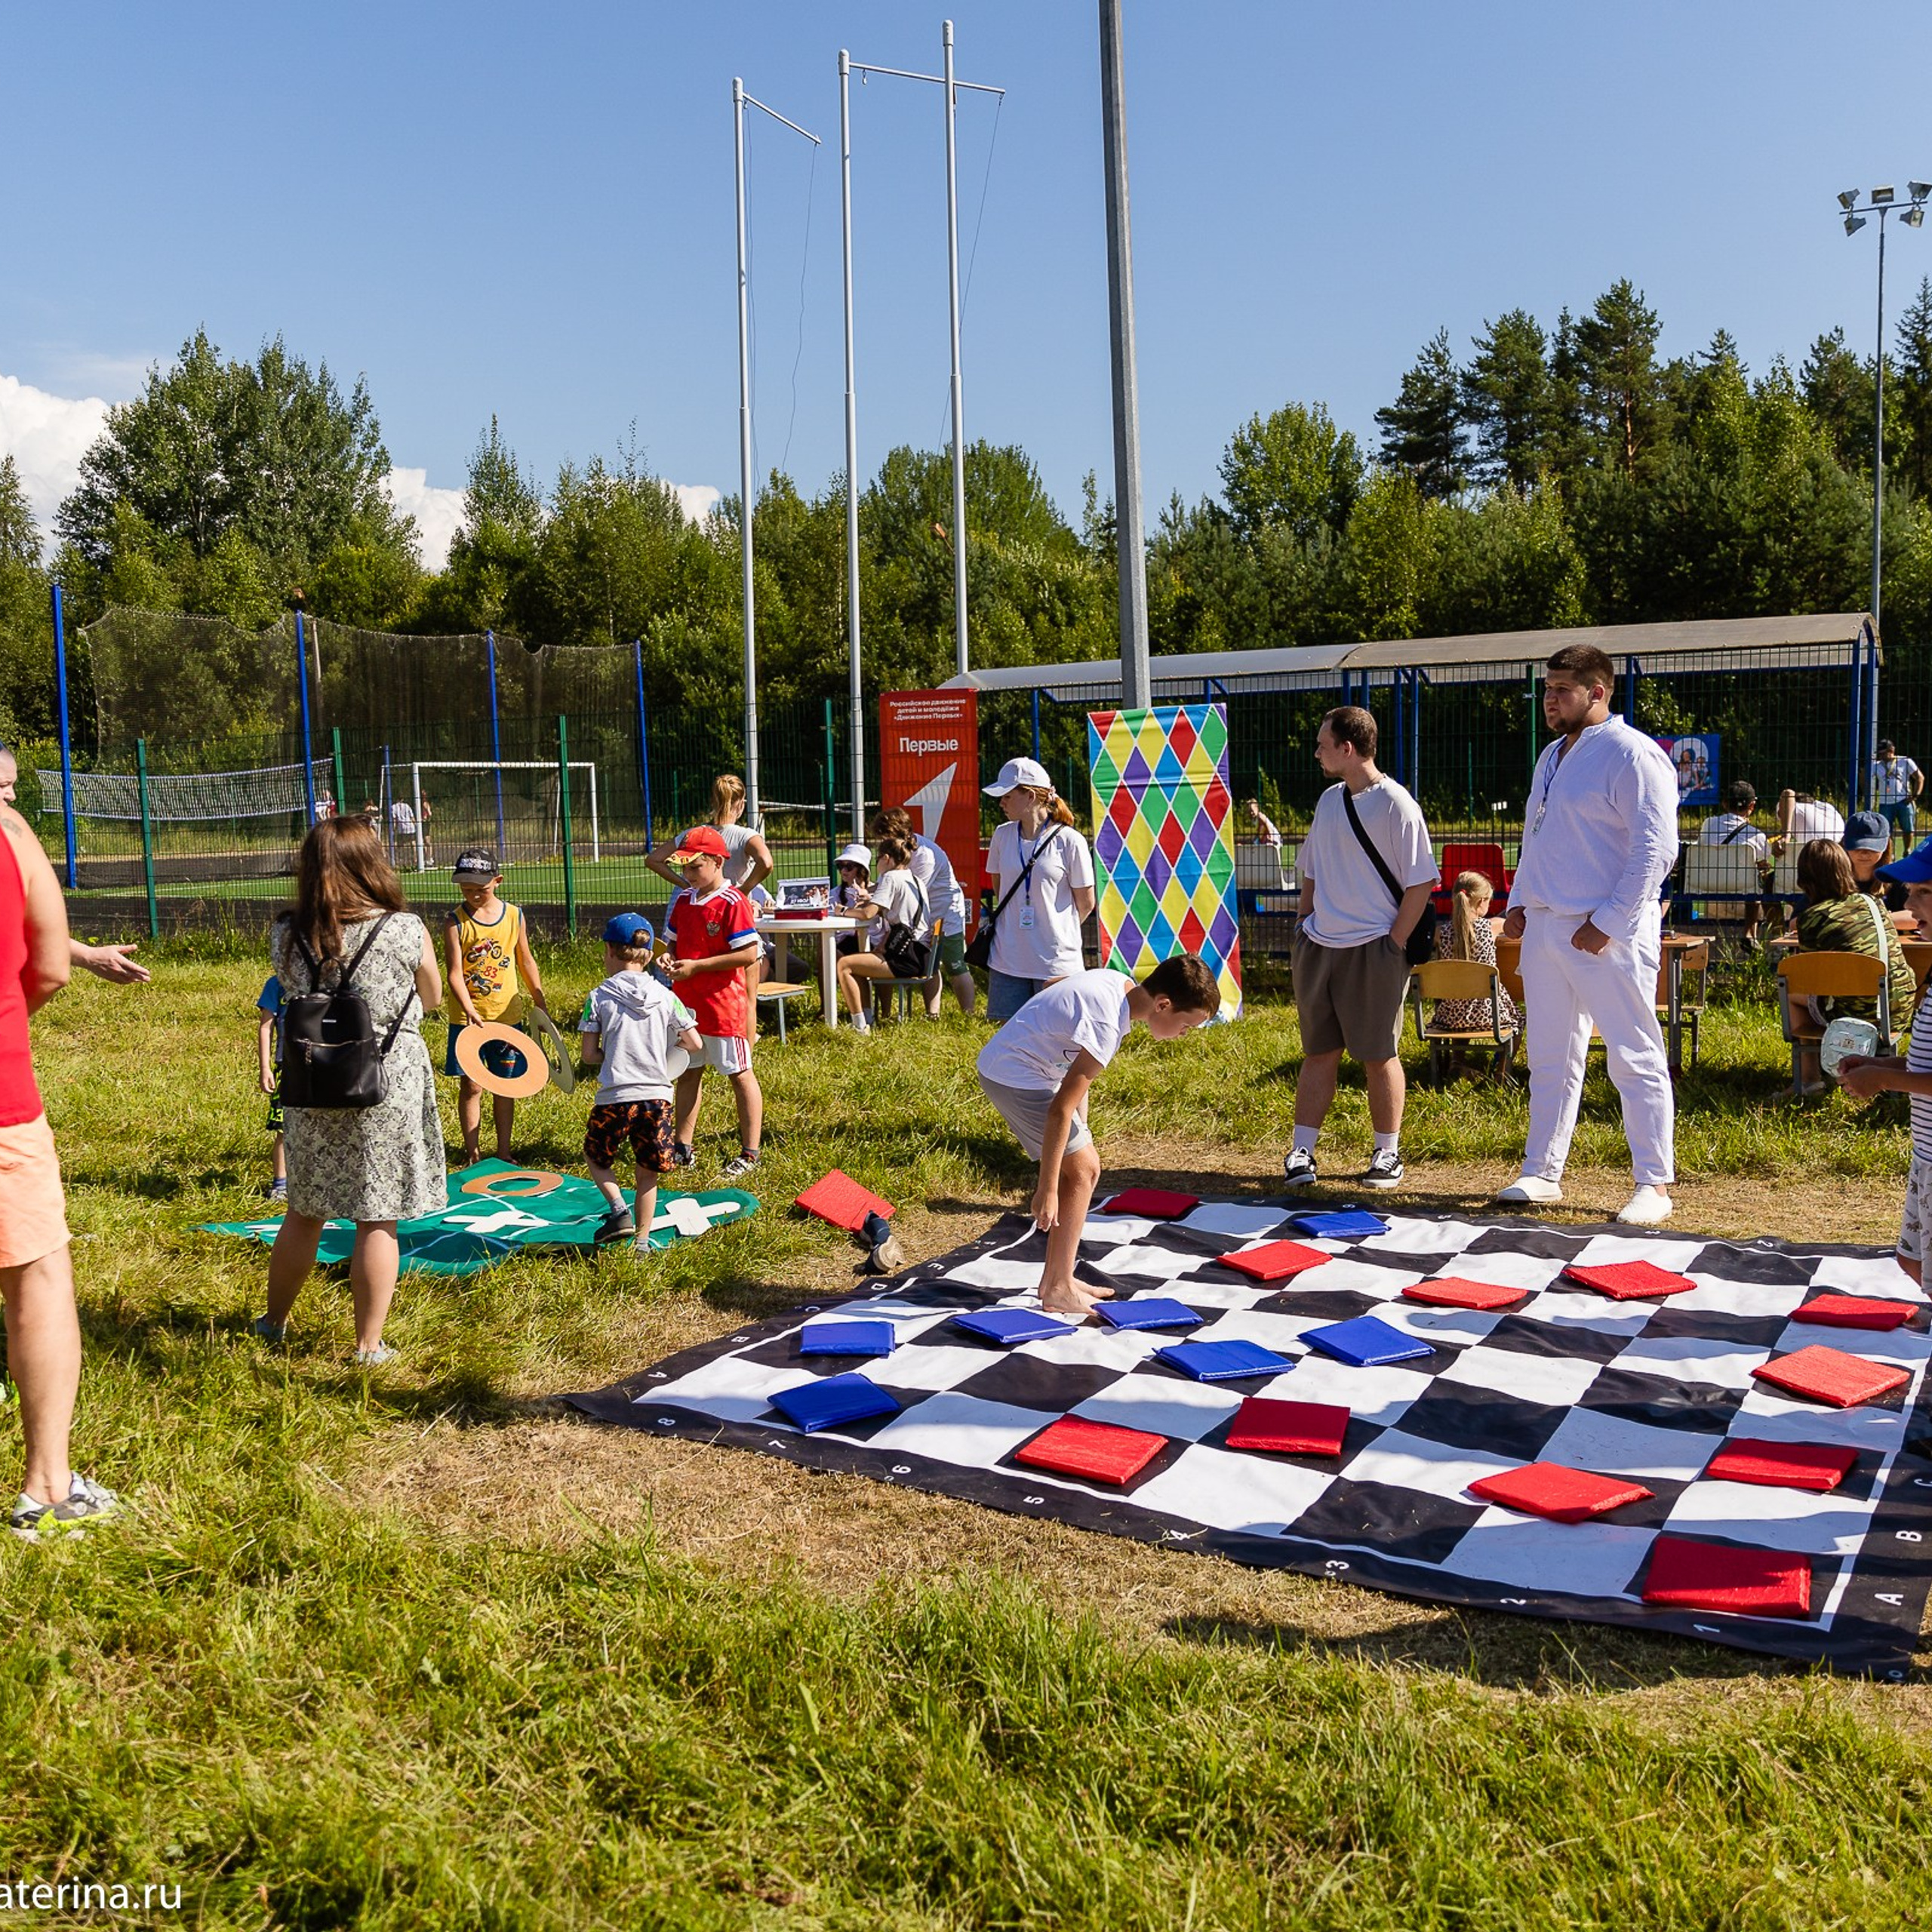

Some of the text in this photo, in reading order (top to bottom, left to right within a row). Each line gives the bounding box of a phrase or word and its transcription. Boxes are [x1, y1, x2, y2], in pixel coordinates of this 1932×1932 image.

[899, 737, 958, 756] Первые
[484, 966, 498, 979] 83
[927, 1263, 945, 1271] E
[871, 1282, 888, 1291] D
[657, 1417, 1721, 1633] 8 7 6 5 4 3 2 1
[1895, 1531, 1922, 1542] B
[1874, 1593, 1904, 1606] A
